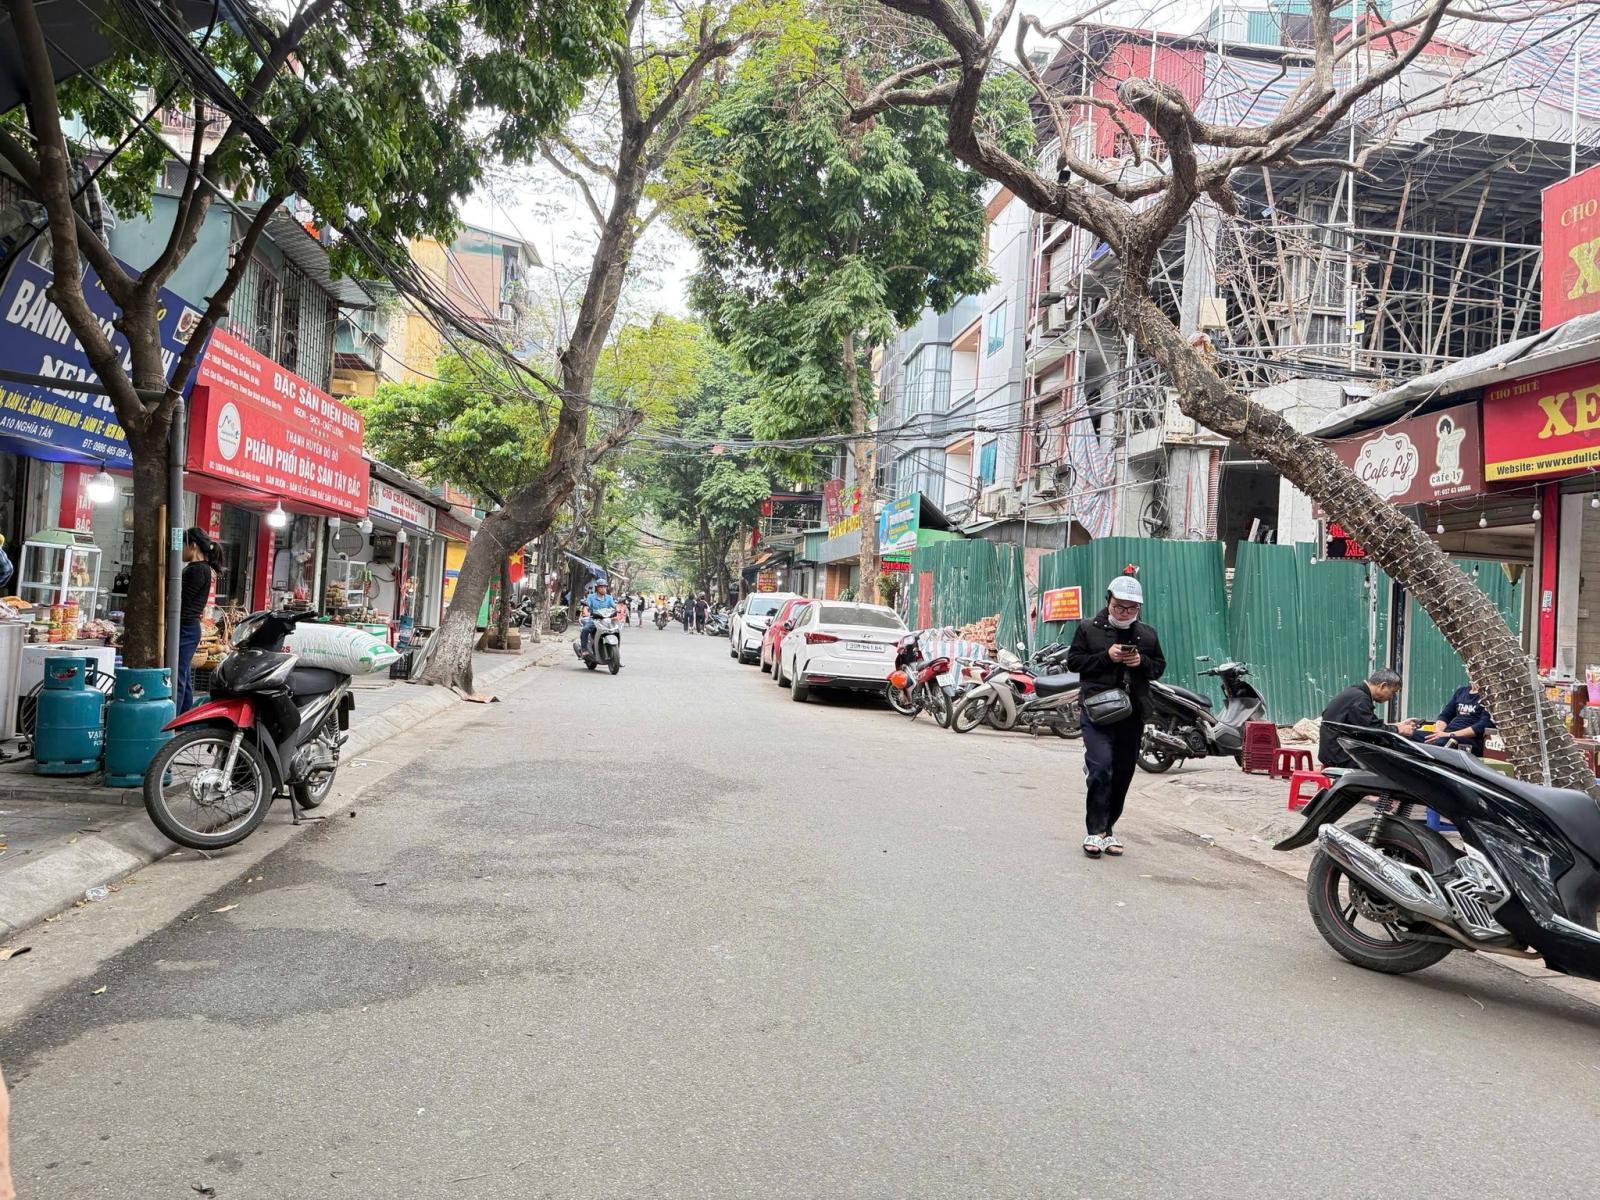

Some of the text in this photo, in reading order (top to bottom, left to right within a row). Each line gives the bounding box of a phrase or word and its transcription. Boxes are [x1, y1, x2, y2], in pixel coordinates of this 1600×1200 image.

[1560, 198, 1597, 227] CHO
[273, 372, 297, 400] ĐẶC
[298, 386, 320, 412] SẢN
[1490, 387, 1510, 401] CHO
[0, 416, 54, 439] A10 NGHĨA TÂN
[286, 429, 305, 448] THANH
[244, 436, 274, 469] PHÂN
[275, 448, 298, 474] PHỐI
[299, 457, 316, 484] ĐẶC
[317, 461, 333, 487] SẢN
[333, 467, 349, 493] TÂY
[1497, 462, 1535, 476] Website:
[1431, 471, 1461, 484] cafe ly
